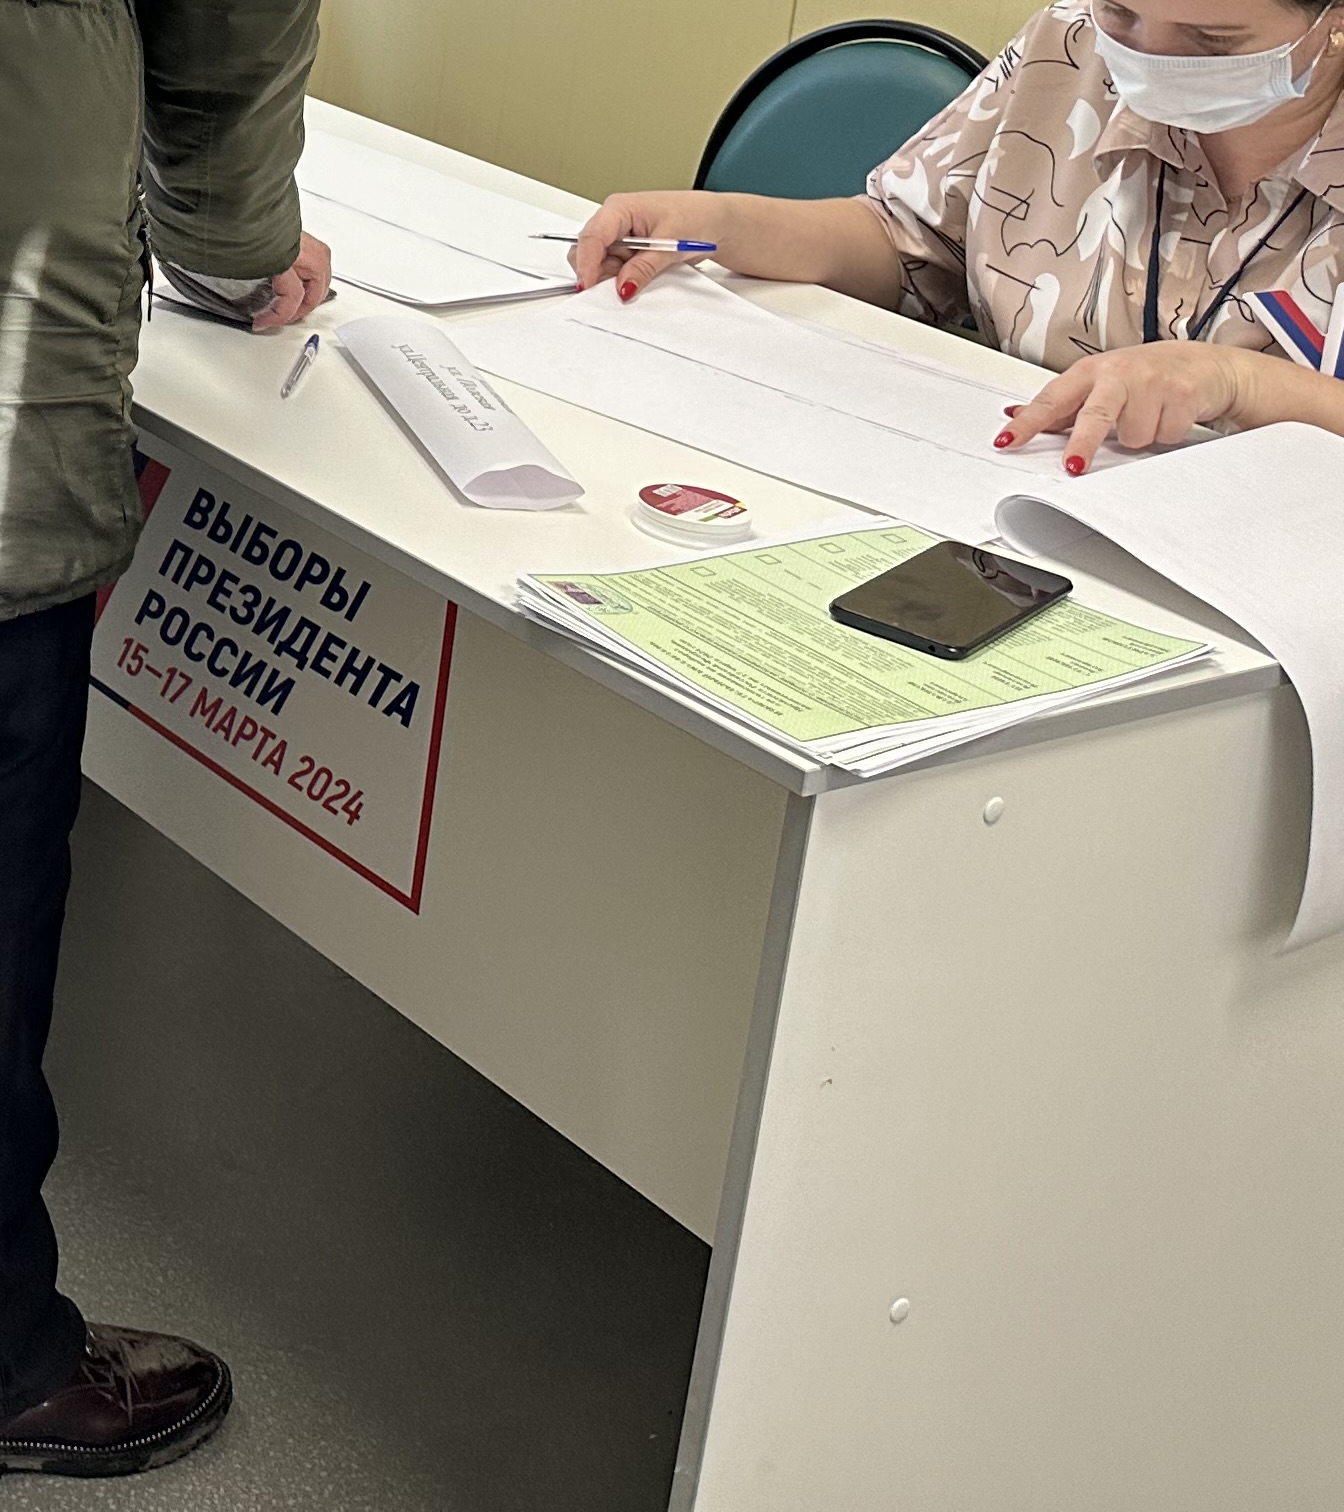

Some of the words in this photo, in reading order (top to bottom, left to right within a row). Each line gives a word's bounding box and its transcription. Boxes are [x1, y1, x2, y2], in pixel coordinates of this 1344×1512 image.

[157, 538, 422, 729] ПРЕЗИДЕНТА
[182, 487, 372, 623] ВЫБОРЫ
[116, 637, 194, 706] 15–17
[188, 686, 290, 777] МАРТА
[287, 755, 365, 828] 2024
[134, 589, 297, 717] РОССИИ
